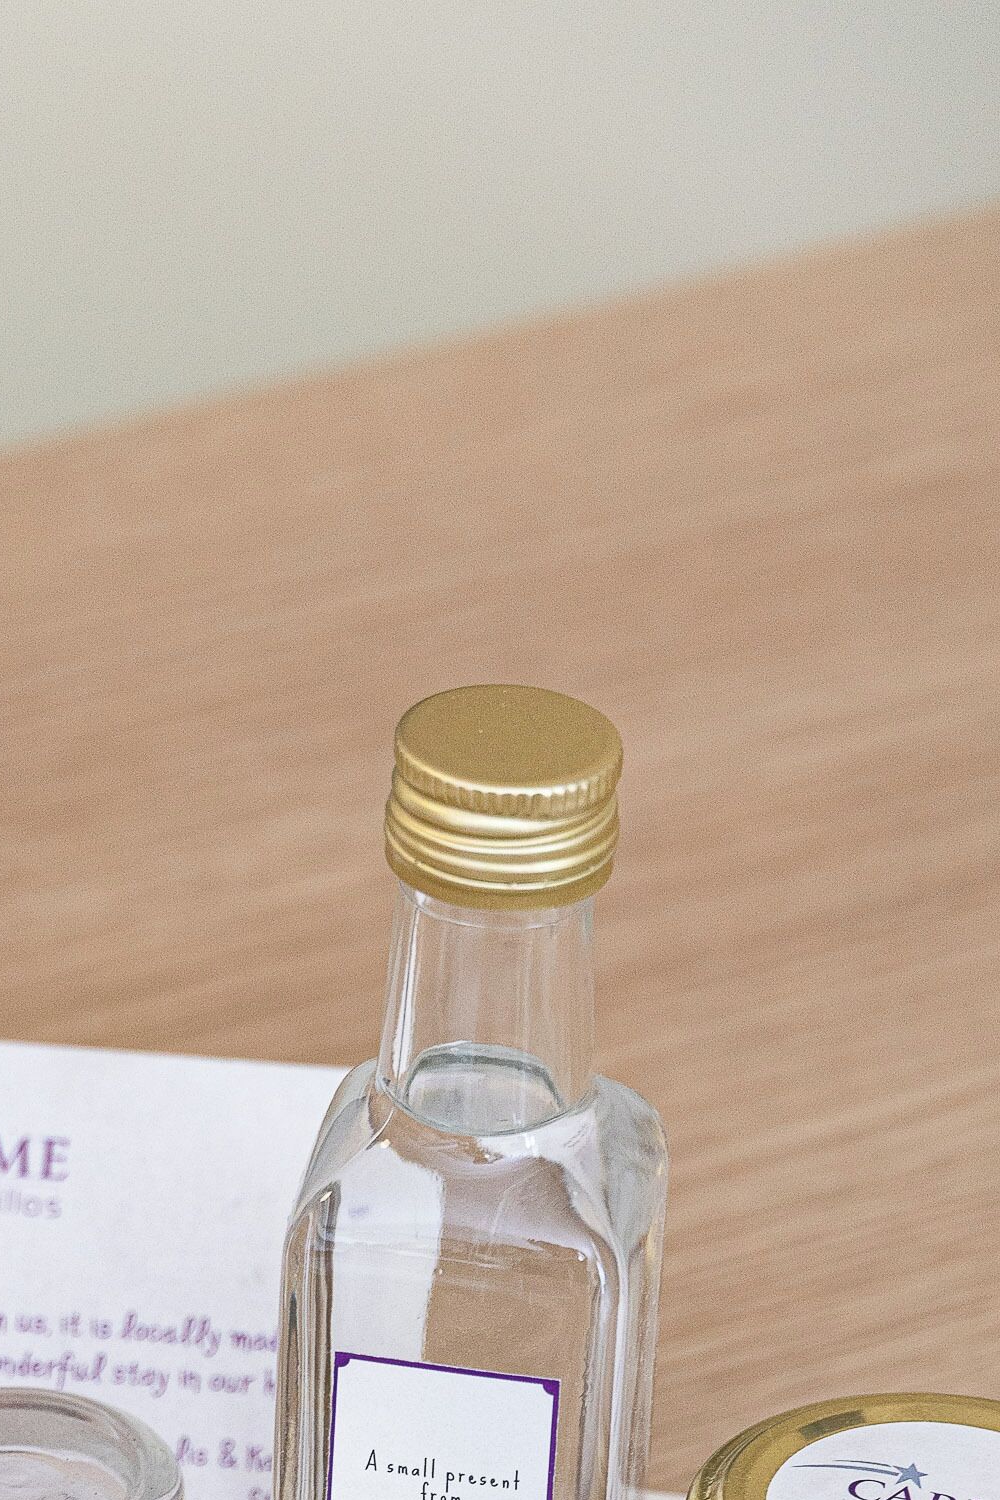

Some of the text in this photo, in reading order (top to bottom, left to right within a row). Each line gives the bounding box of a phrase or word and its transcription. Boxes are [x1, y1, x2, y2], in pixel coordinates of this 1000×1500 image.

[59, 1311, 81, 1337] it
[91, 1315, 112, 1339] is
[122, 1309, 221, 1357] locally
[112, 1364, 171, 1397] stay
[178, 1370, 201, 1394] in
[208, 1375, 254, 1395] our
[217, 1438, 238, 1469] &
[365, 1449, 521, 1492] A small present
